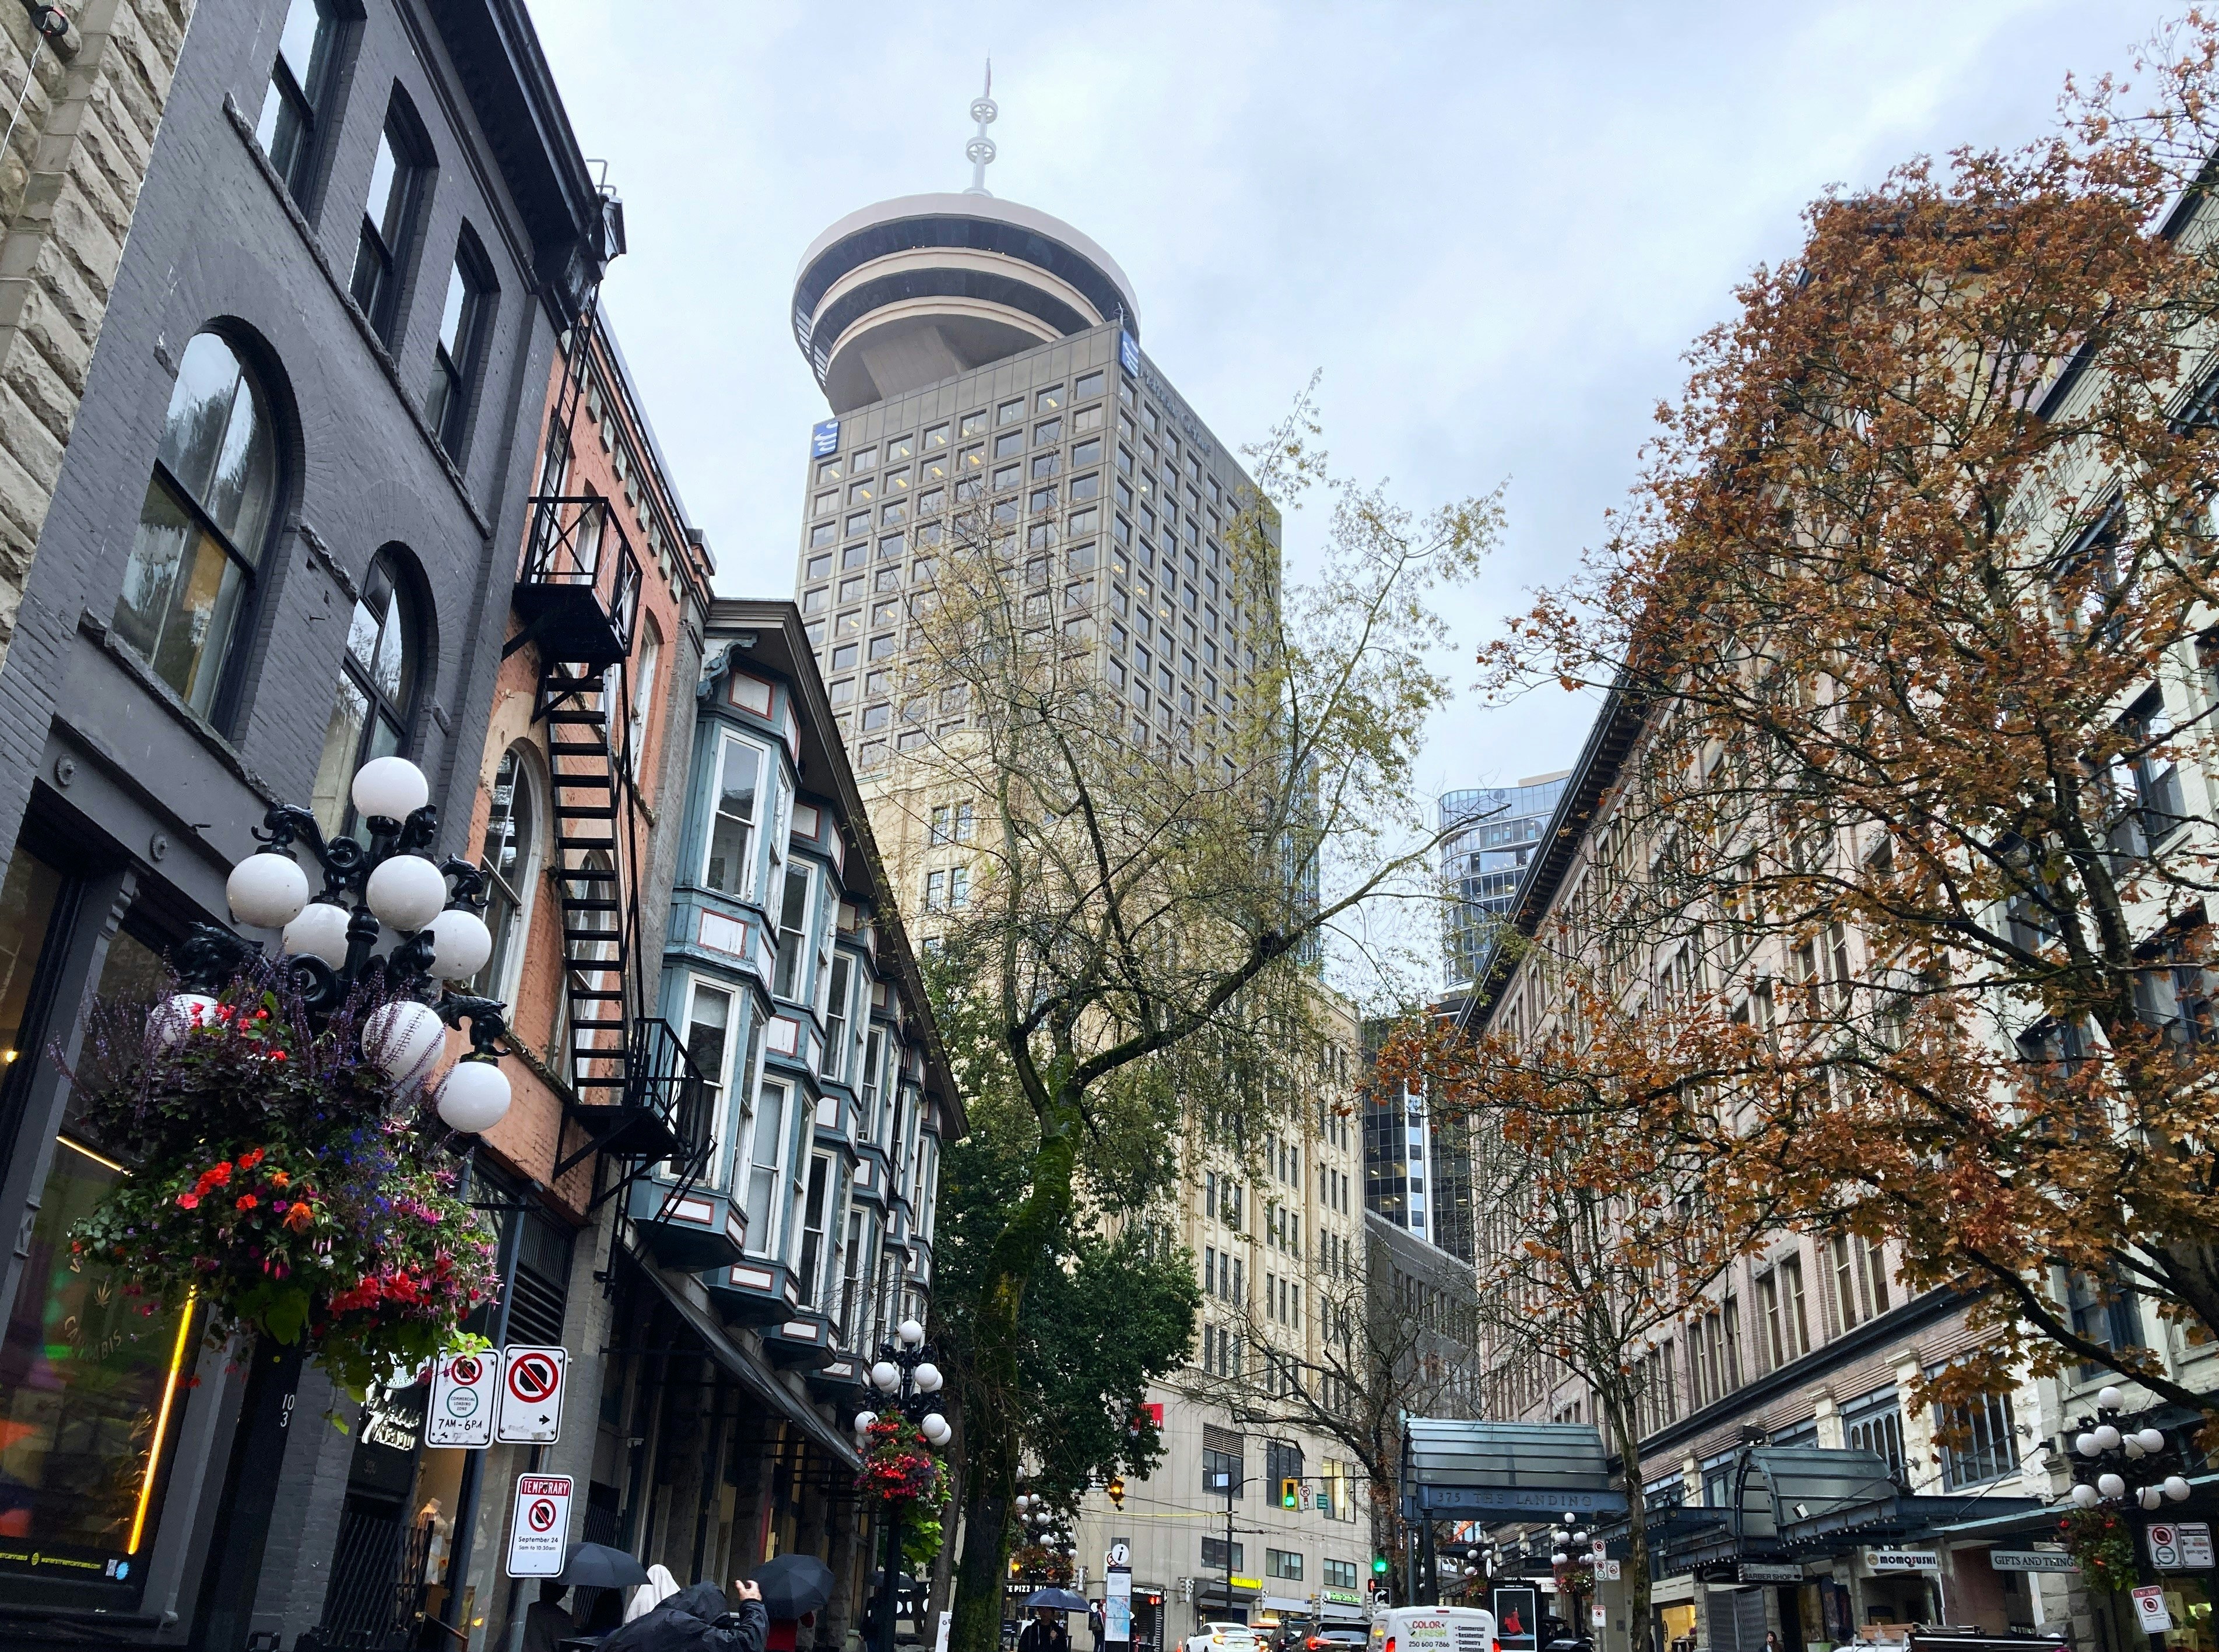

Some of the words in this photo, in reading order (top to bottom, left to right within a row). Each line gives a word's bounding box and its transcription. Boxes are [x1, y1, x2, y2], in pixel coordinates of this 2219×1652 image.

[438, 1418, 457, 1429] 7AM
[524, 1481, 568, 1495] TEMPORARY
[1437, 1492, 1460, 1503] 375
[1473, 1493, 1504, 1504] THE
[1516, 1494, 1592, 1506] LANDING
[1995, 1556, 2021, 1565] GIFTS
[2023, 1556, 2042, 1566] AND
[2043, 1557, 2074, 1567] THING
[1412, 1621, 1441, 1629] COLOR
